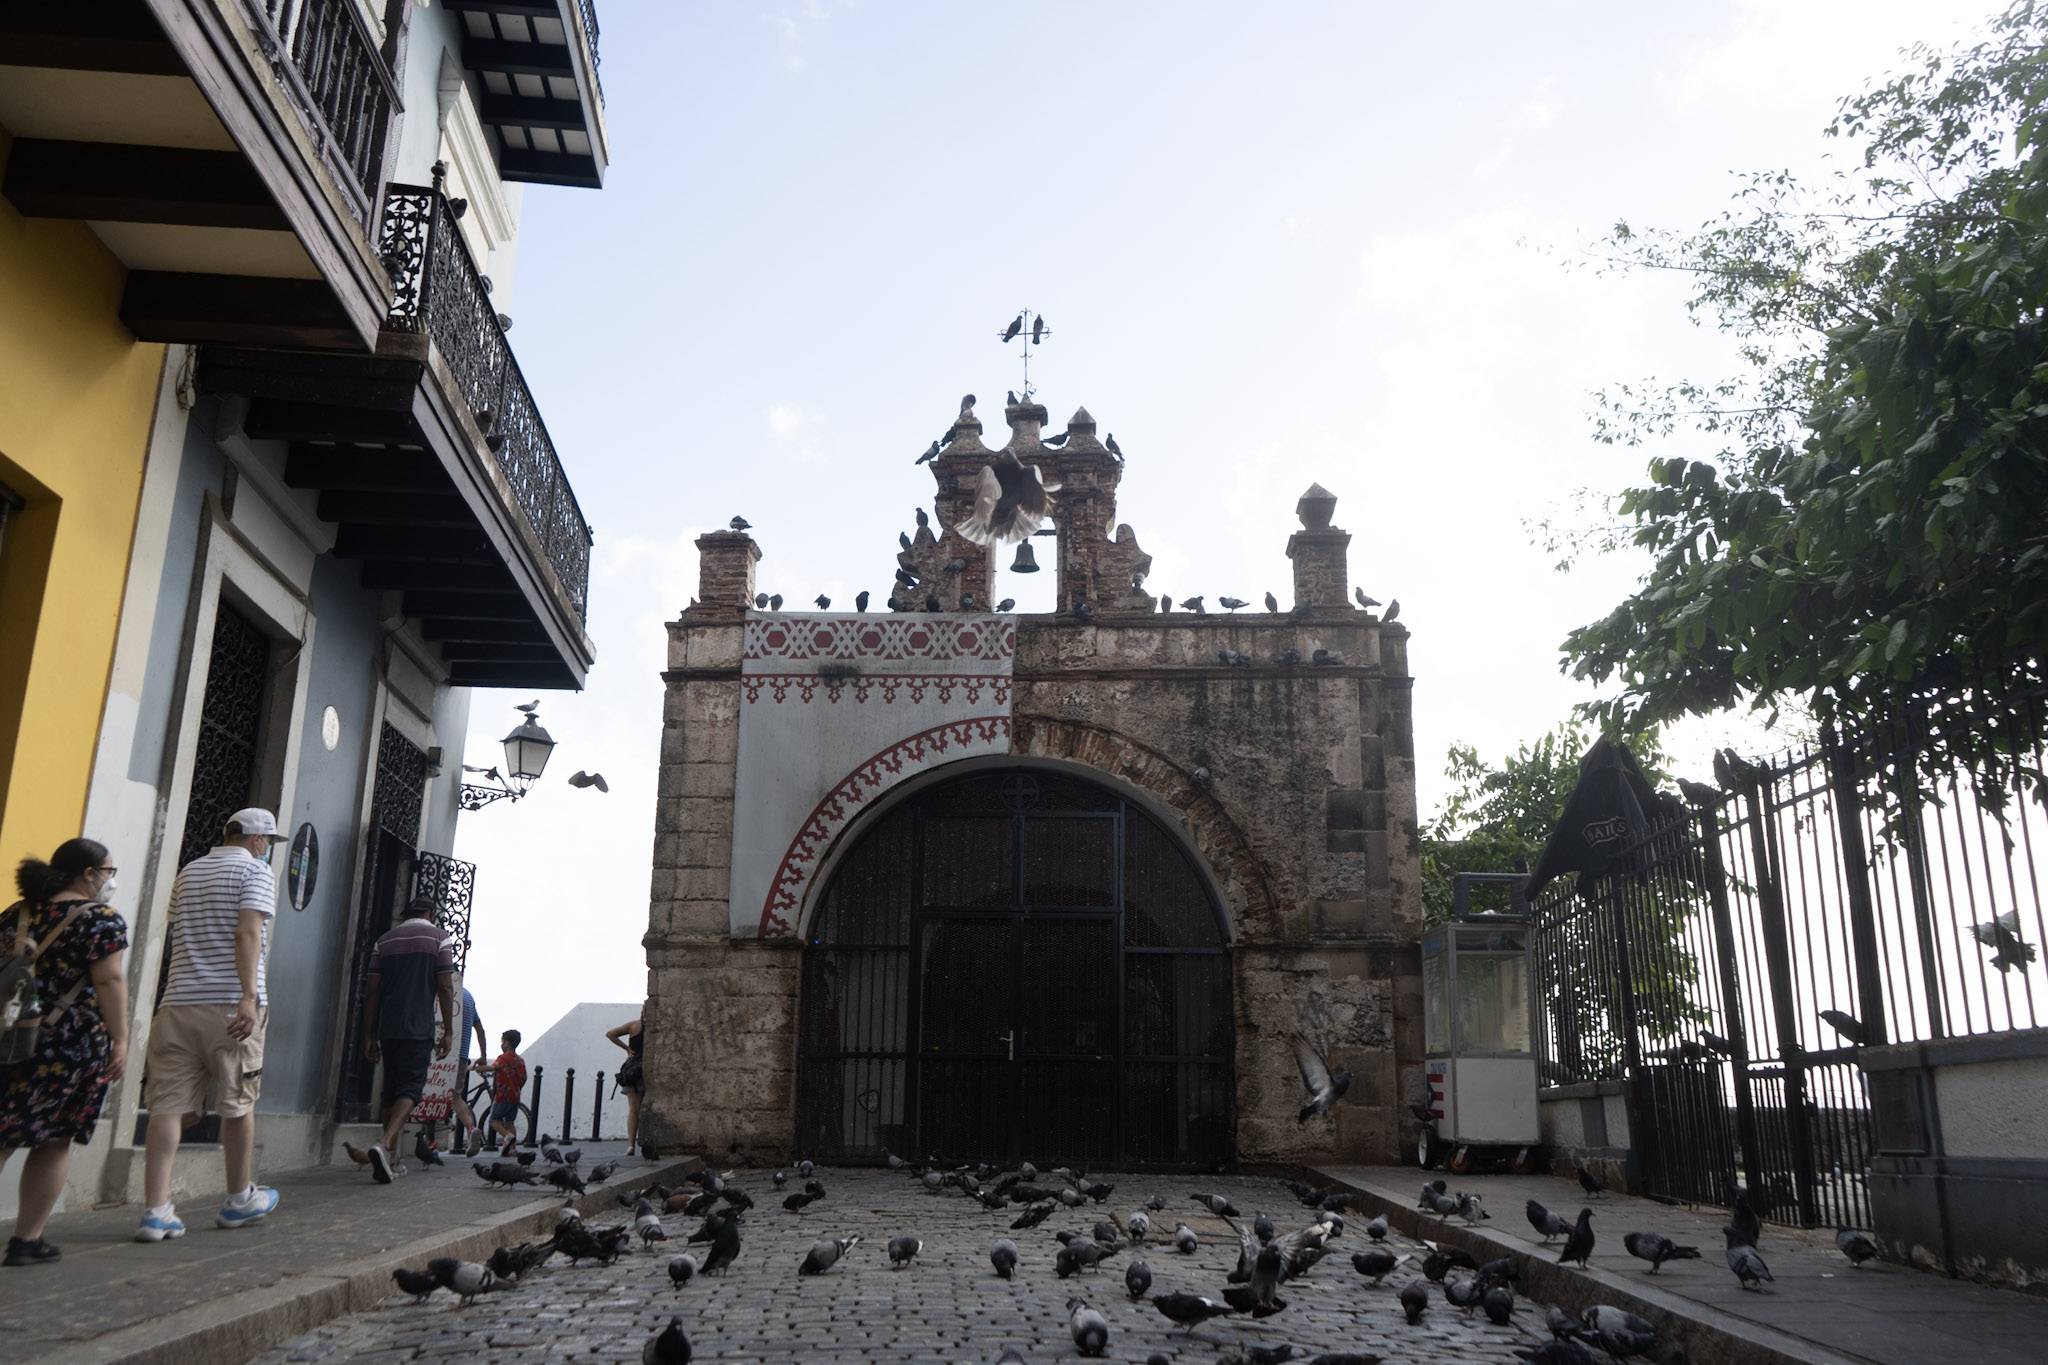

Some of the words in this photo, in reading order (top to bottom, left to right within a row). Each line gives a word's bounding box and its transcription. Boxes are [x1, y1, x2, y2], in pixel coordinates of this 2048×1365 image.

[427, 1062, 456, 1073] namese
[426, 1071, 447, 1087] dles
[410, 1101, 447, 1118] 62-6479
